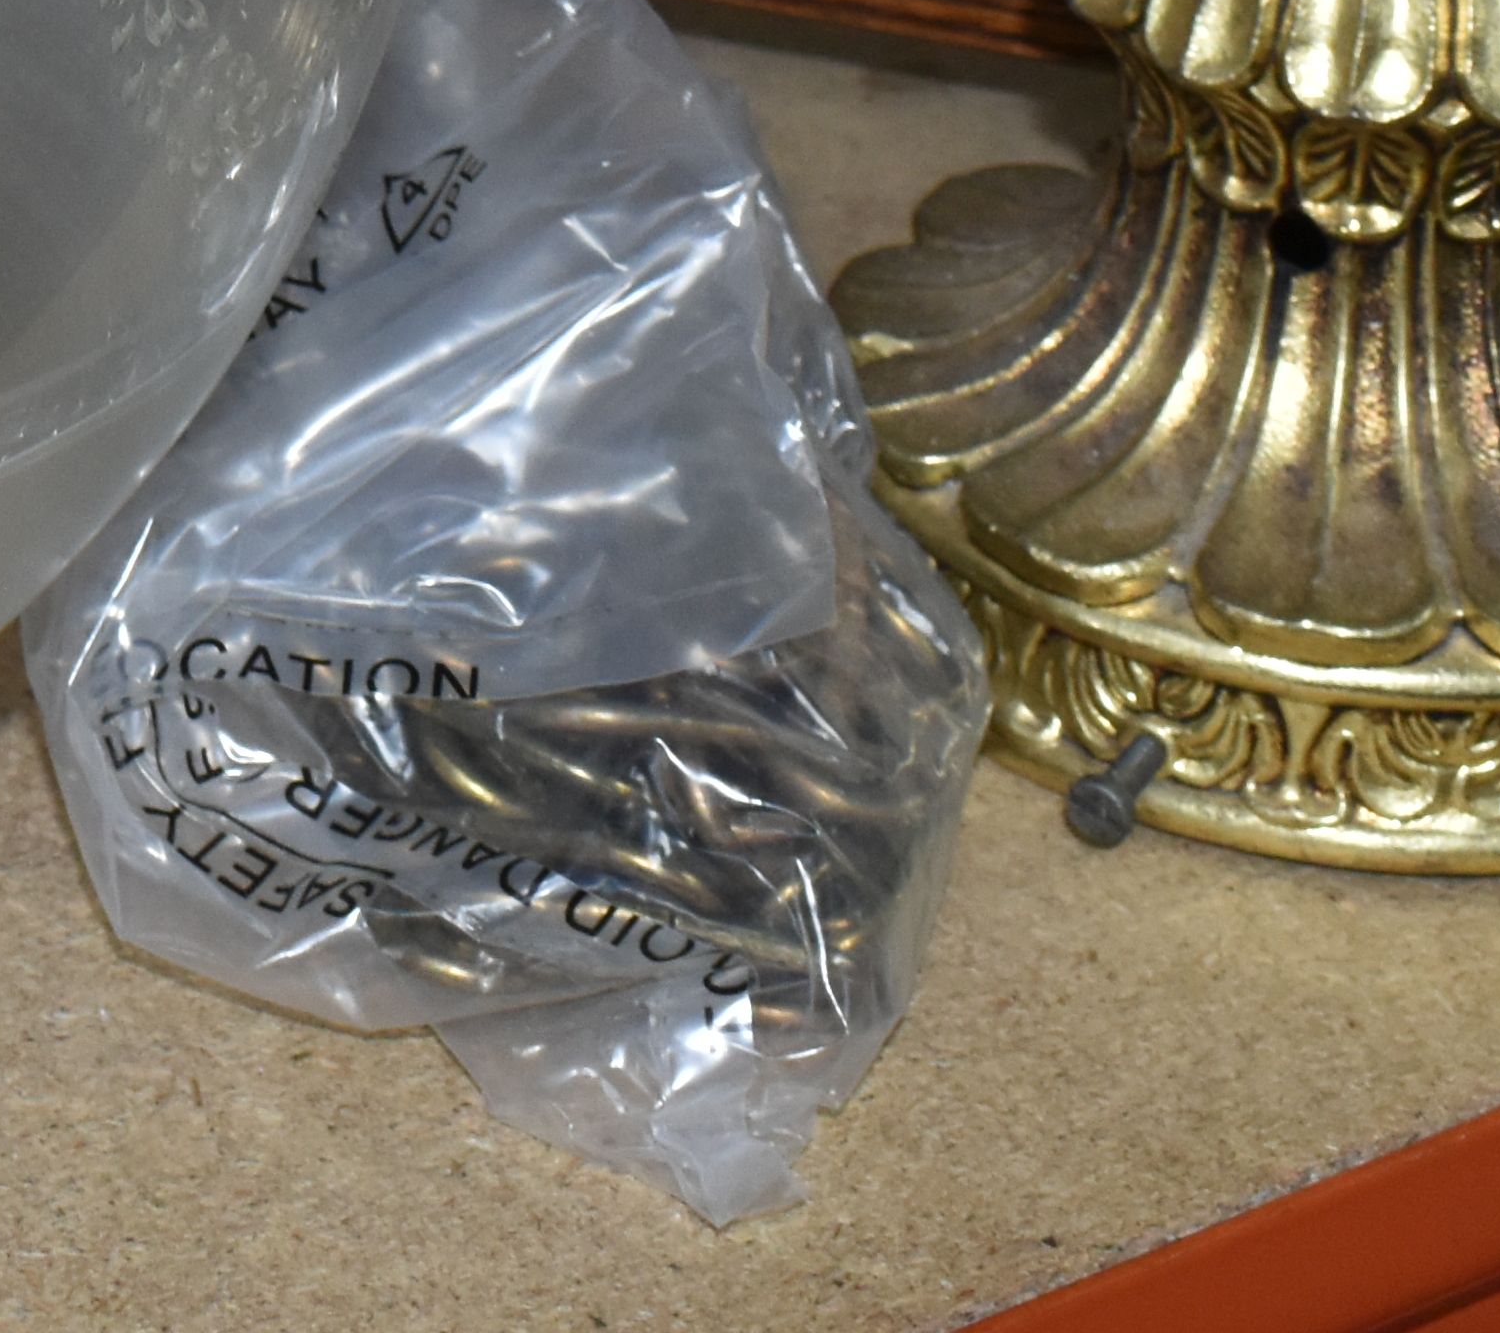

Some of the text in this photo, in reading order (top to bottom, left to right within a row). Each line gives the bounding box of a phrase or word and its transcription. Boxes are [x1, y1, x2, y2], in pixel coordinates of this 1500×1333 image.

[249, 257, 327, 341] AY
[116, 637, 481, 700] OCATION
[140, 804, 375, 918] SAFETY
